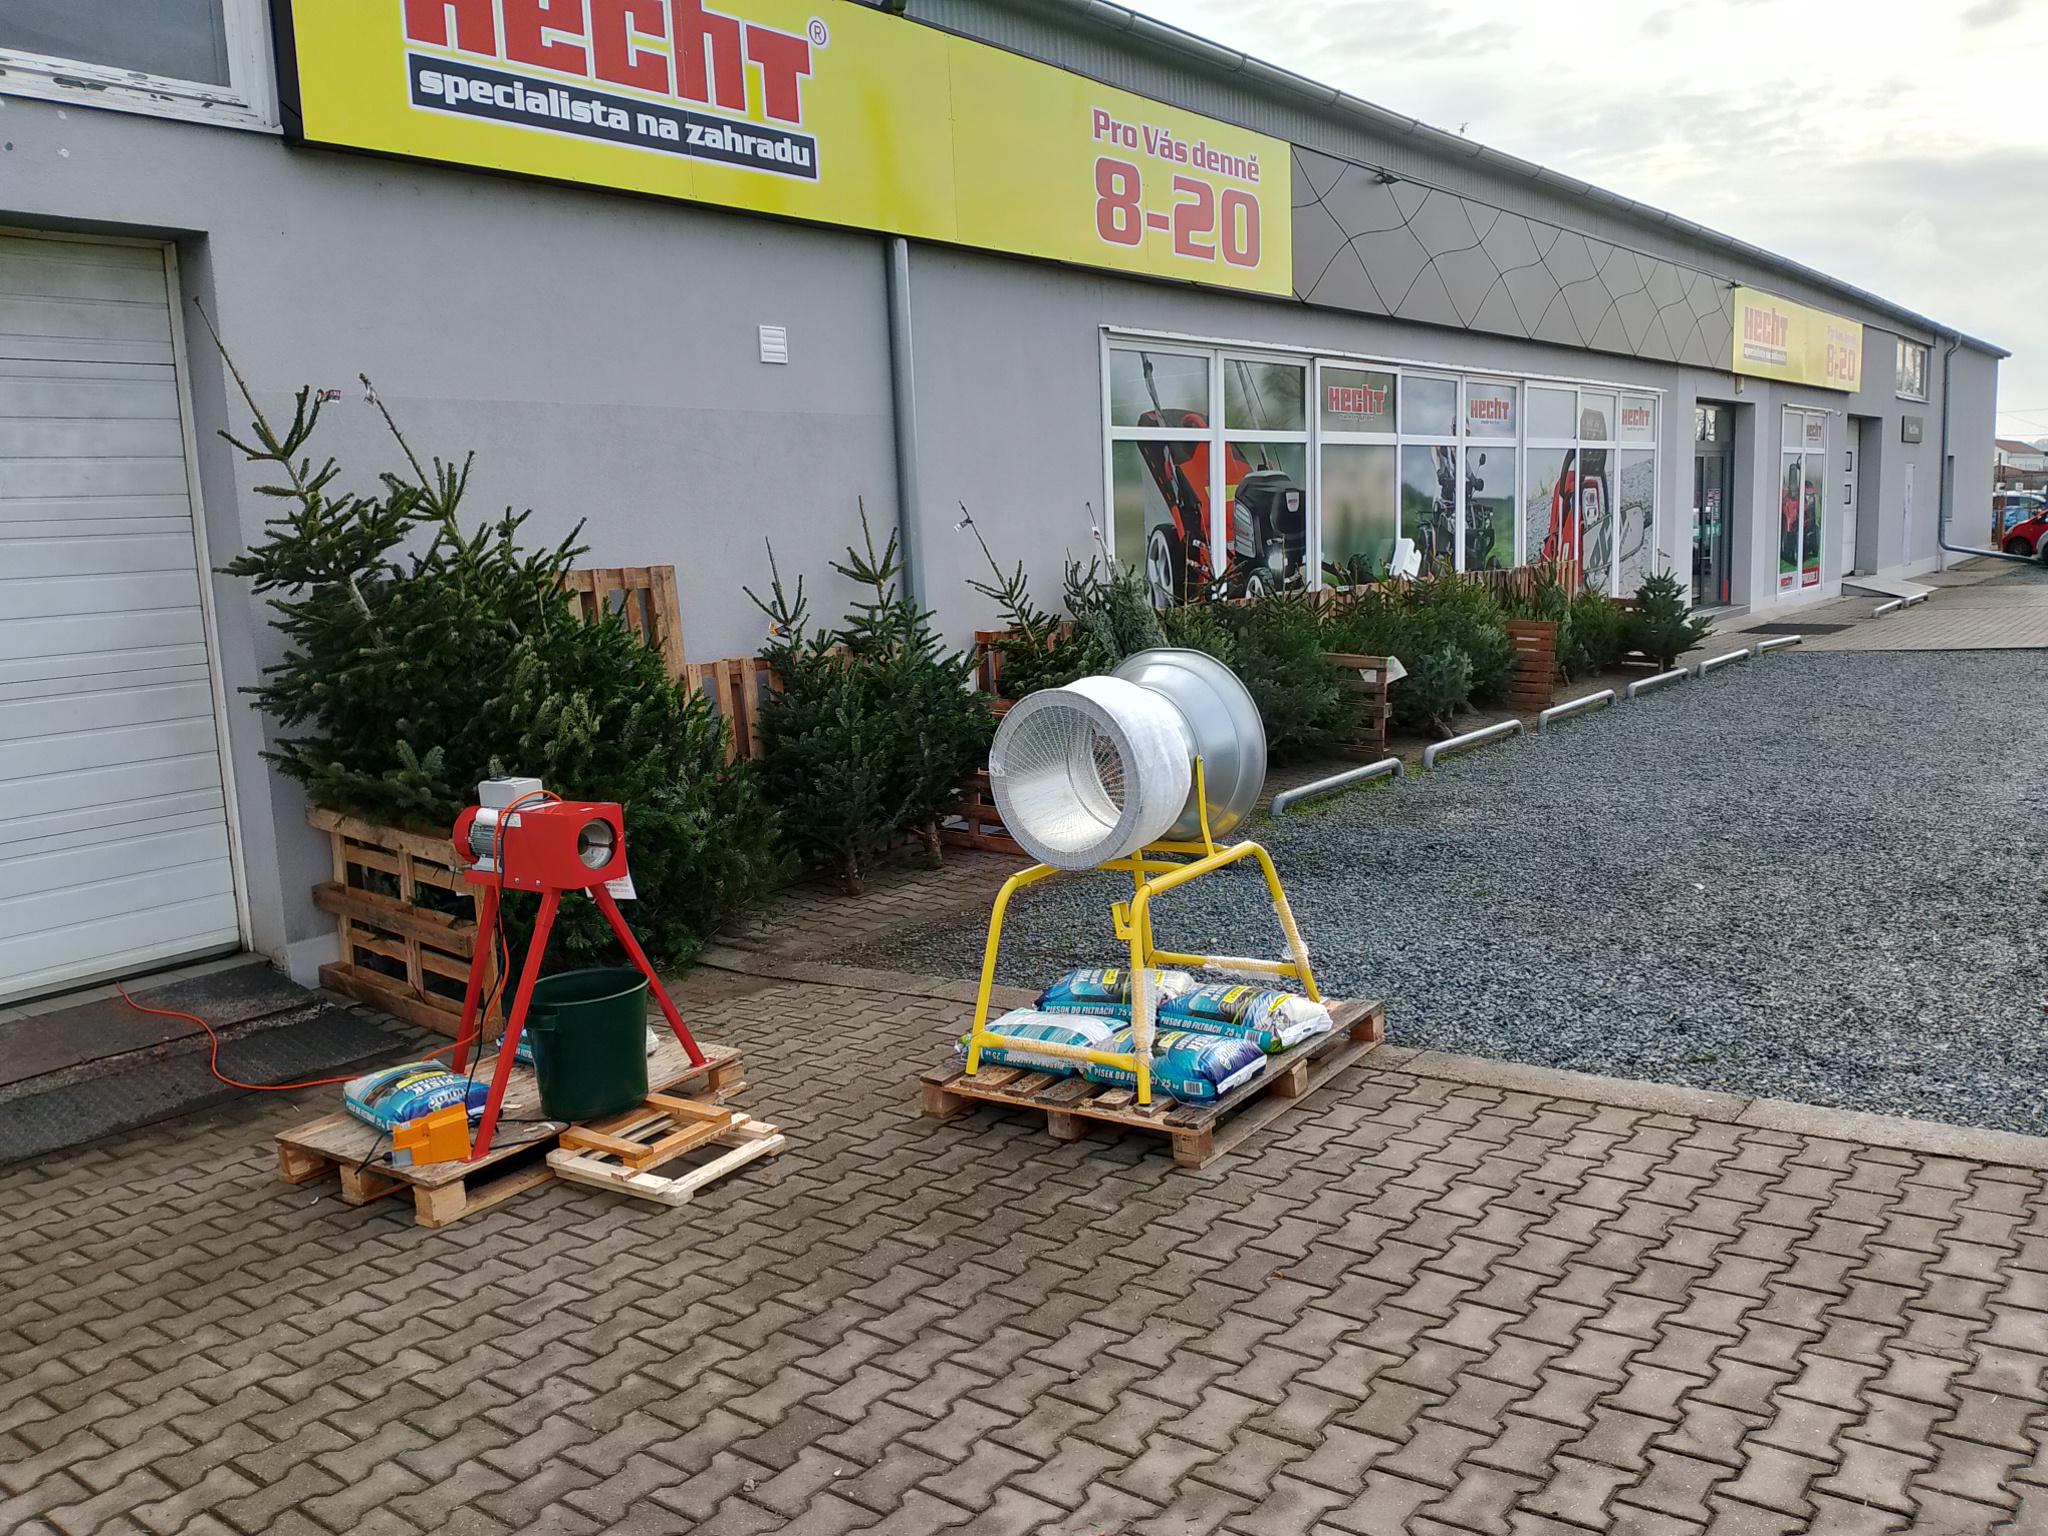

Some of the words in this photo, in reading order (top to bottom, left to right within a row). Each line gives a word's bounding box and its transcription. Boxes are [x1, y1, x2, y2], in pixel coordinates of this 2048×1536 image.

[419, 68, 630, 132] specialista
[637, 113, 679, 141] na
[686, 120, 810, 167] zahradu
[1093, 109, 1138, 149] Pro
[1142, 125, 1187, 163] Vás
[1192, 141, 1260, 182] denně
[1095, 157, 1260, 268] 8-20
[1827, 344, 1855, 381] 8-20
[1224, 1027, 1235, 1037] 25
[1161, 1078, 1172, 1089] 25
